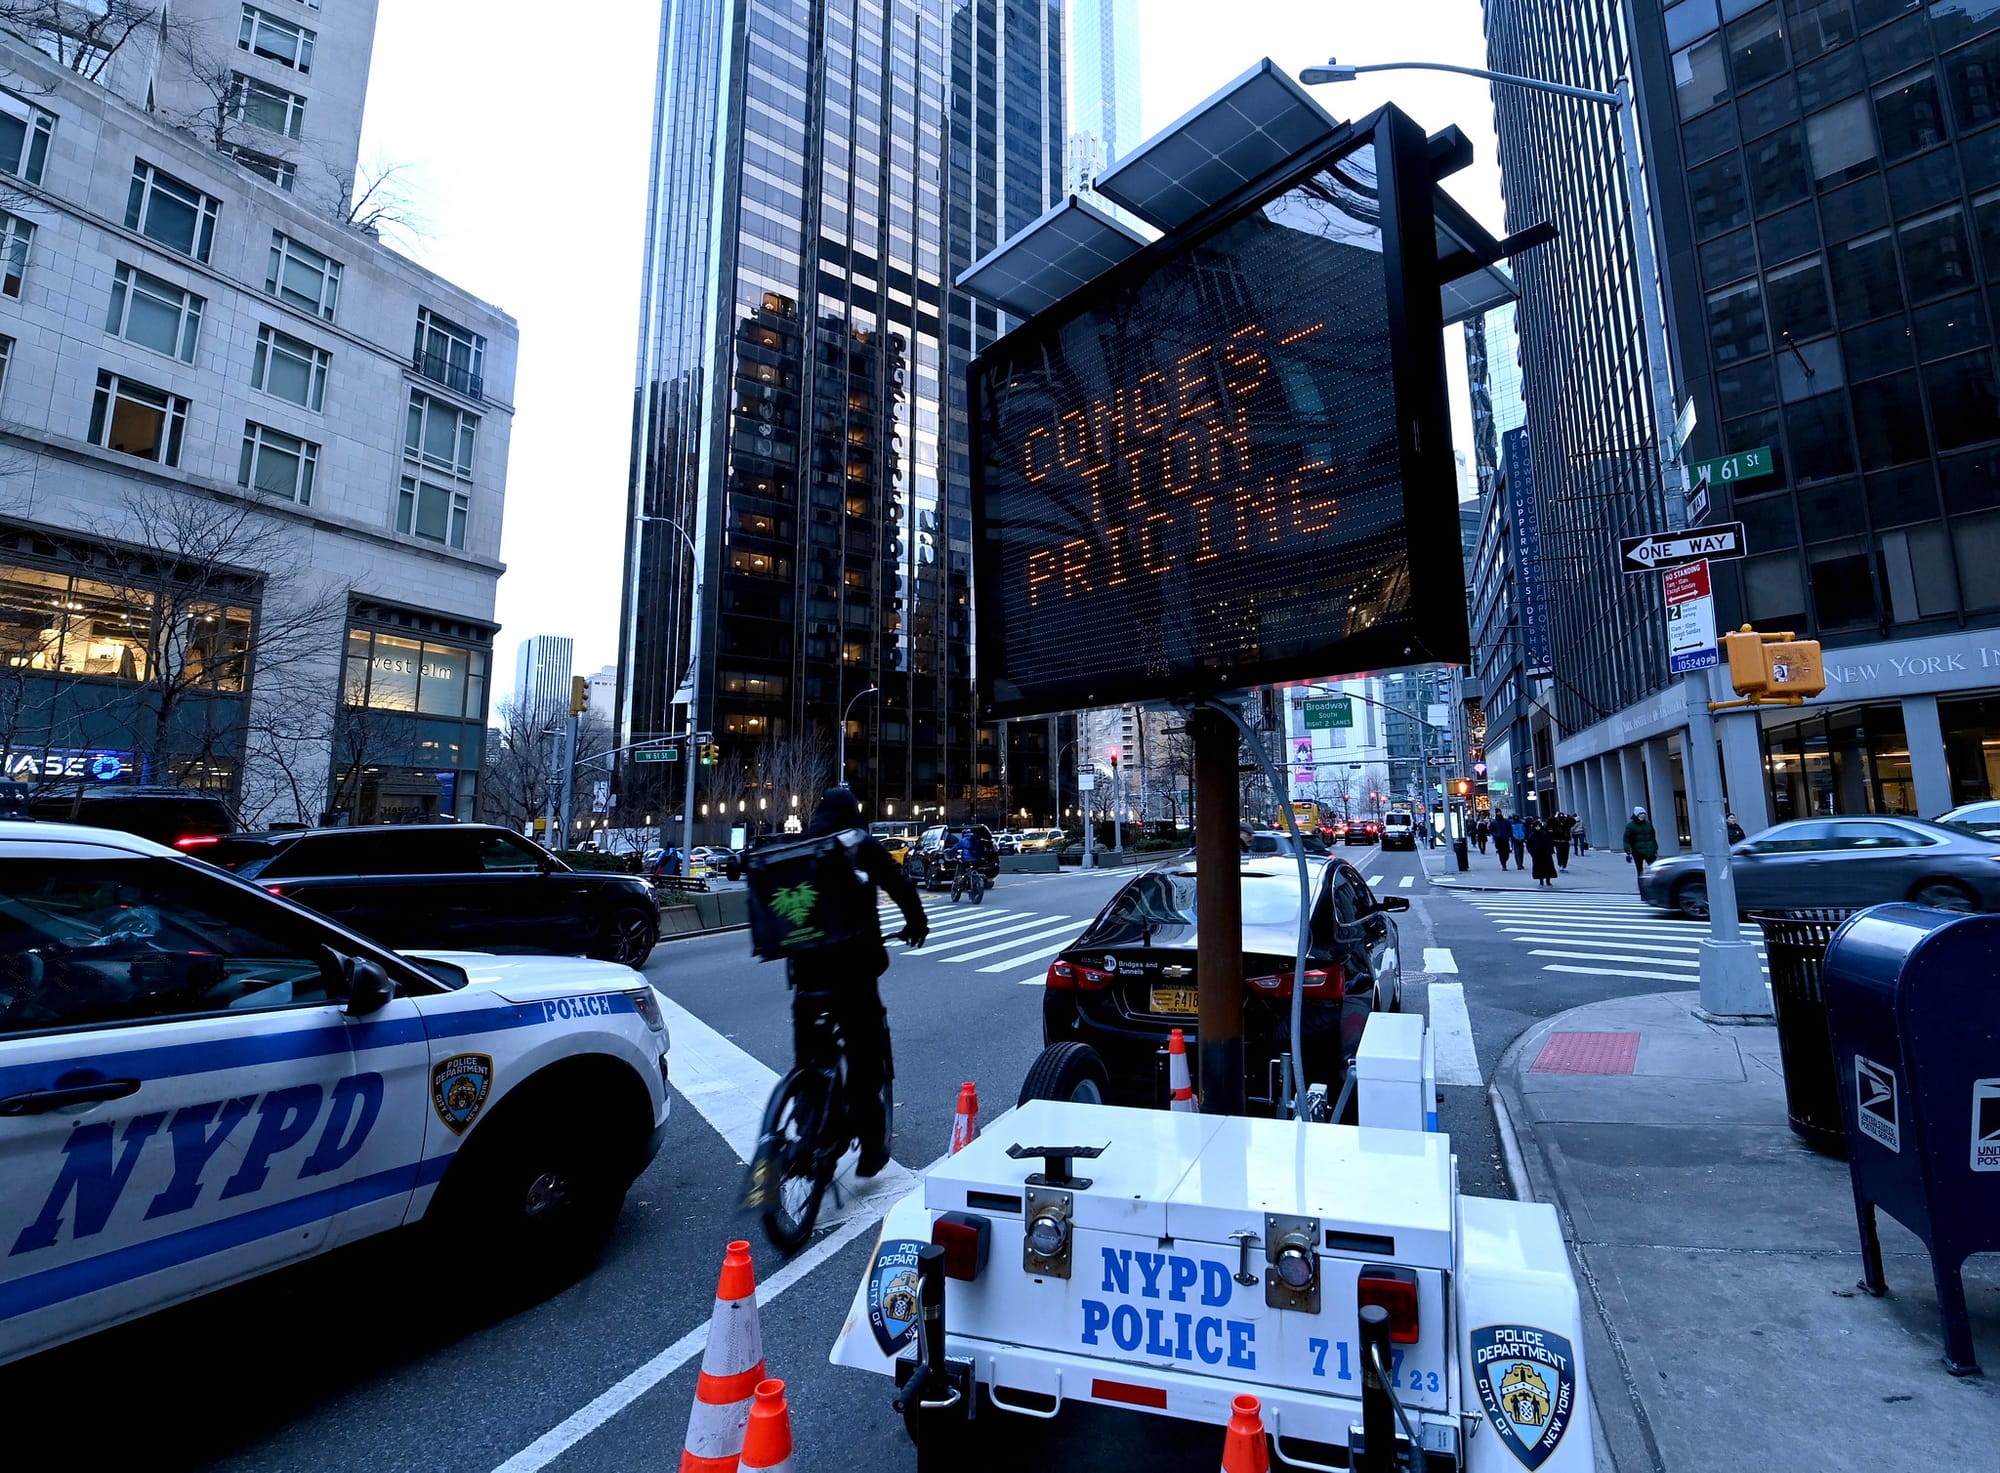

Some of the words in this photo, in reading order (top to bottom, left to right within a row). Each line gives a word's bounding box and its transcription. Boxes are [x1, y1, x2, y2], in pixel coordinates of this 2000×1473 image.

[1080, 406, 1250, 524] TION
[1697, 464, 1711, 483] W
[1721, 458, 1739, 480] 61
[1746, 453, 1760, 467] St
[1028, 459, 1339, 607] PRICING
[1639, 544, 1672, 560] ONE
[1689, 535, 1727, 553] WAY
[1665, 573, 1674, 582] NO
[1673, 563, 1701, 579] STANDING
[1671, 606, 1679, 620] 2
[419, 662, 453, 680] elm
[1678, 656, 1706, 670] 105249
[1823, 663, 1881, 685] NEW
[1888, 653, 1968, 678] YORK
[1306, 701, 1349, 711] Broadway
[1118, 960, 1144, 968] Bridges
[1119, 967, 1144, 975] Tunnels
[544, 995, 610, 1022] POLICE
[435, 1065, 488, 1085] DEPARTMENT
[447, 1057, 478, 1070] POLICE
[435, 1093, 447, 1112] CITY
[444, 1114, 455, 1122] OF
[465, 1104, 480, 1122] NEW
[478, 1079, 489, 1101] YORK
[9, 1071, 385, 1258] NYPD
[878, 1254, 918, 1268] DEPART
[1101, 1246, 1233, 1308] NYPD
[871, 1280, 879, 1308] CITY
[871, 1311, 883, 1328] OF
[904, 1321, 918, 1340] NE
[1081, 1298, 1256, 1371] POLICE
[1495, 1329, 1545, 1347] POLICE
[1477, 1343, 1567, 1371] DEPARTMENT
[1409, 1369, 1440, 1393] 23
[1479, 1378, 1498, 1413] CITY
[1495, 1417, 1513, 1436] OF
[1542, 1417, 1563, 1448] NEW
[1557, 1381, 1570, 1415] YORK
